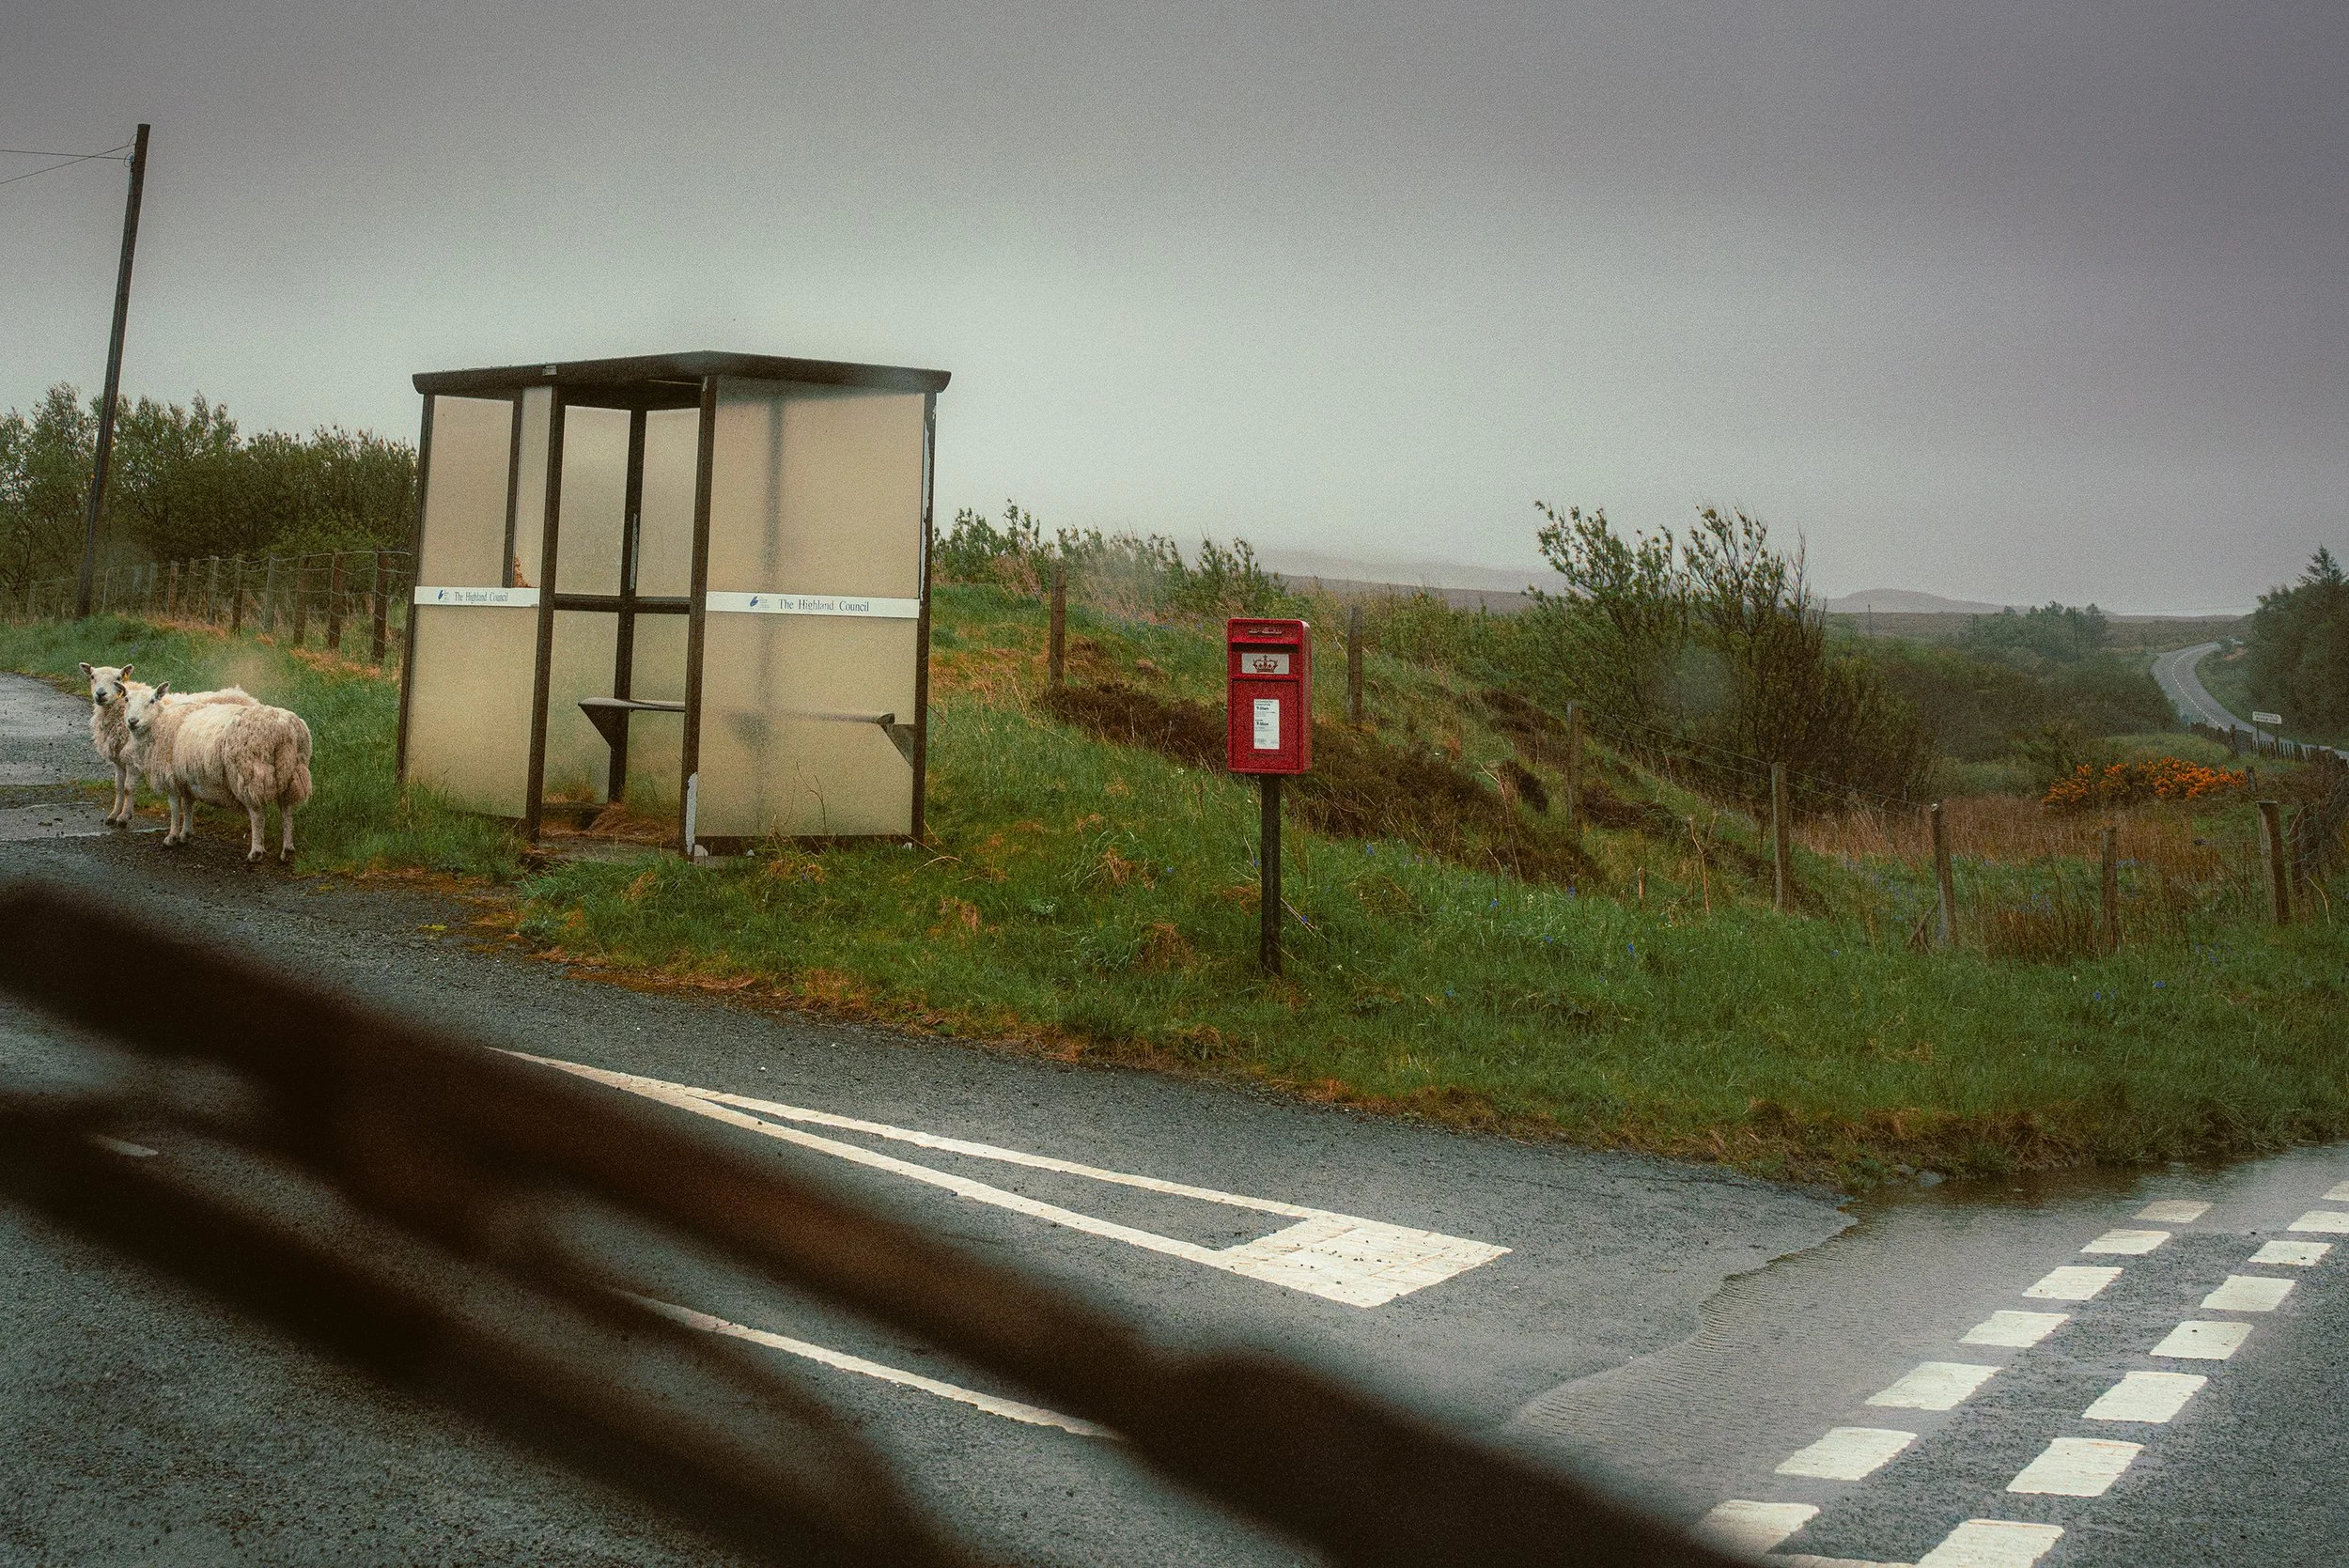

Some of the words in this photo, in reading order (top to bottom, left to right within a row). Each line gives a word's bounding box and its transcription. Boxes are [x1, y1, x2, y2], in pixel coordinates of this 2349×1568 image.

[455, 591, 463, 602] The
[465, 592, 488, 604] Highland
[490, 593, 508, 602] Council
[779, 599, 794, 610] The
[798, 599, 834, 613] Highland
[839, 600, 869, 612] Council
